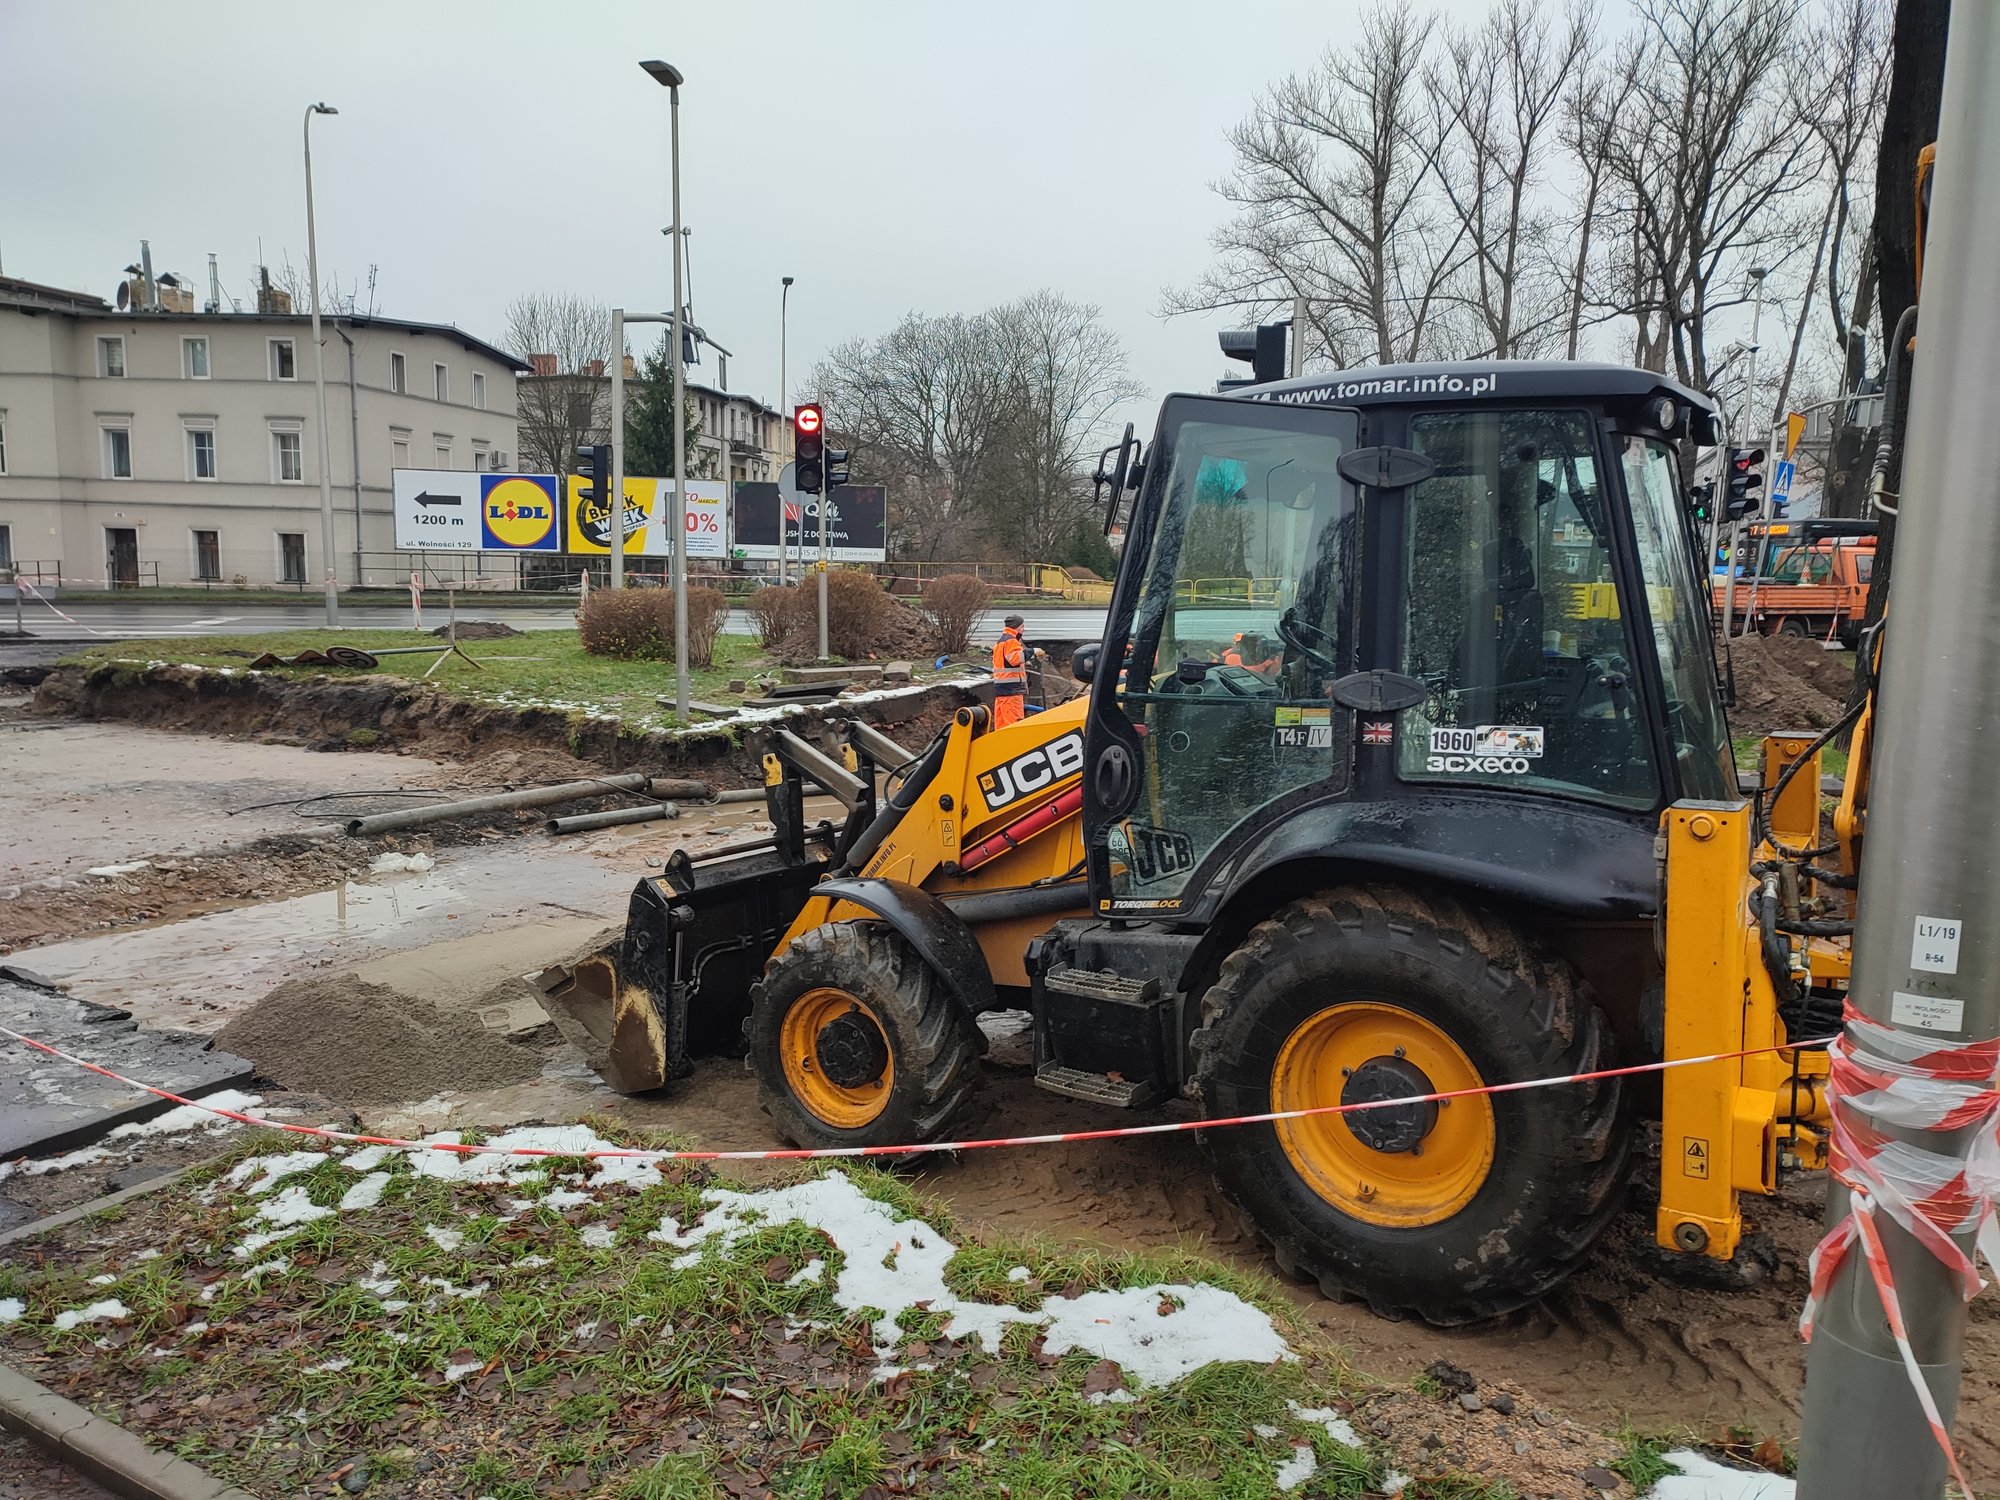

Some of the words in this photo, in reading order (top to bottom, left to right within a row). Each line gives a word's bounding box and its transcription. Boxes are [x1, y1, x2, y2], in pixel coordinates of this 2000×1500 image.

[1279, 373, 1496, 404] www.tomar.info.pl
[413, 515, 446, 525] 1200
[452, 517, 463, 526] m
[594, 508, 644, 533] WEK
[419, 540, 455, 548] Wolności
[1432, 731, 1473, 752] 1960
[986, 734, 1084, 807] JCB
[1137, 829, 1190, 880] JCB
[1919, 924, 1956, 940] L1/19
[1925, 953, 1944, 964] R-54
[1920, 1020, 1933, 1028] 45
